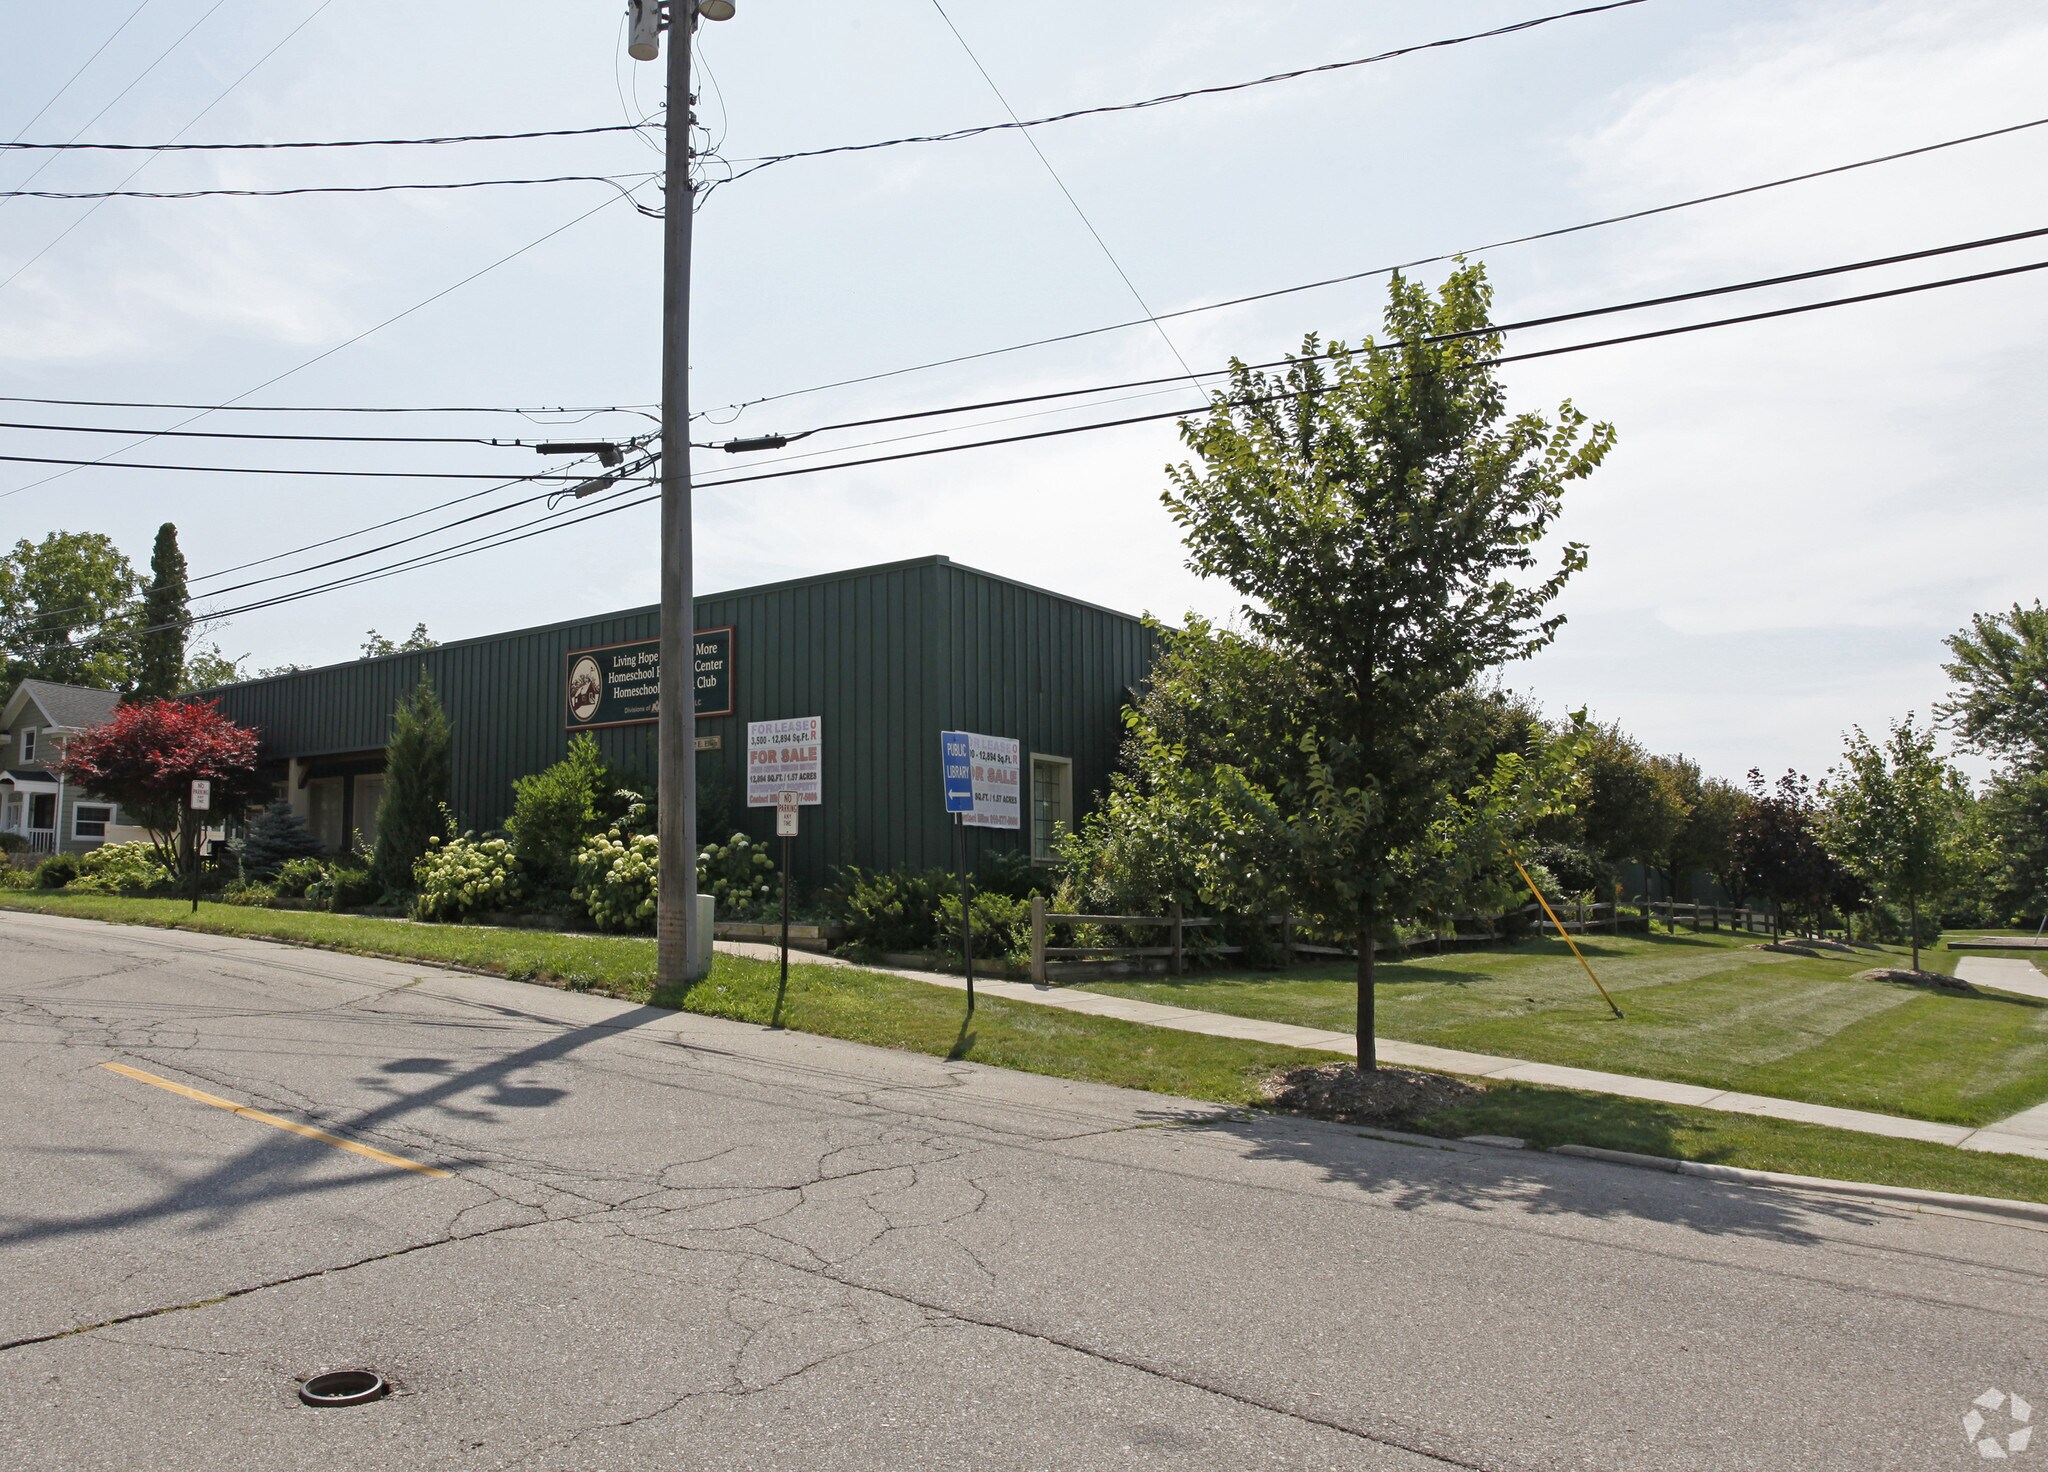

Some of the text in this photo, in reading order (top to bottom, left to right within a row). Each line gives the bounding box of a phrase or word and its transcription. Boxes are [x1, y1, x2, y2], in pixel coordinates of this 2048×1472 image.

[613, 643, 718, 668] Living Hope More
[608, 666, 655, 684] Homeschool
[694, 660, 723, 672] Center
[613, 675, 717, 698] Homeschool Club
[624, 706, 645, 714] Divisions
[751, 720, 809, 735] FOR LEASE
[751, 736, 766, 746] 3,500
[772, 734, 791, 744] 12,894
[793, 733, 809, 743] Sq.Ft.
[982, 739, 1012, 753] LEASE
[751, 747, 817, 765] FOR SALE
[947, 743, 966, 757] PUBLIC
[980, 751, 996, 762] 12,894
[799, 772, 817, 780] ACRES
[947, 765, 969, 779] LIBRARY
[987, 767, 1018, 785] SALE
[784, 795, 791, 803] NO
[1003, 795, 1017, 804] ACRES
